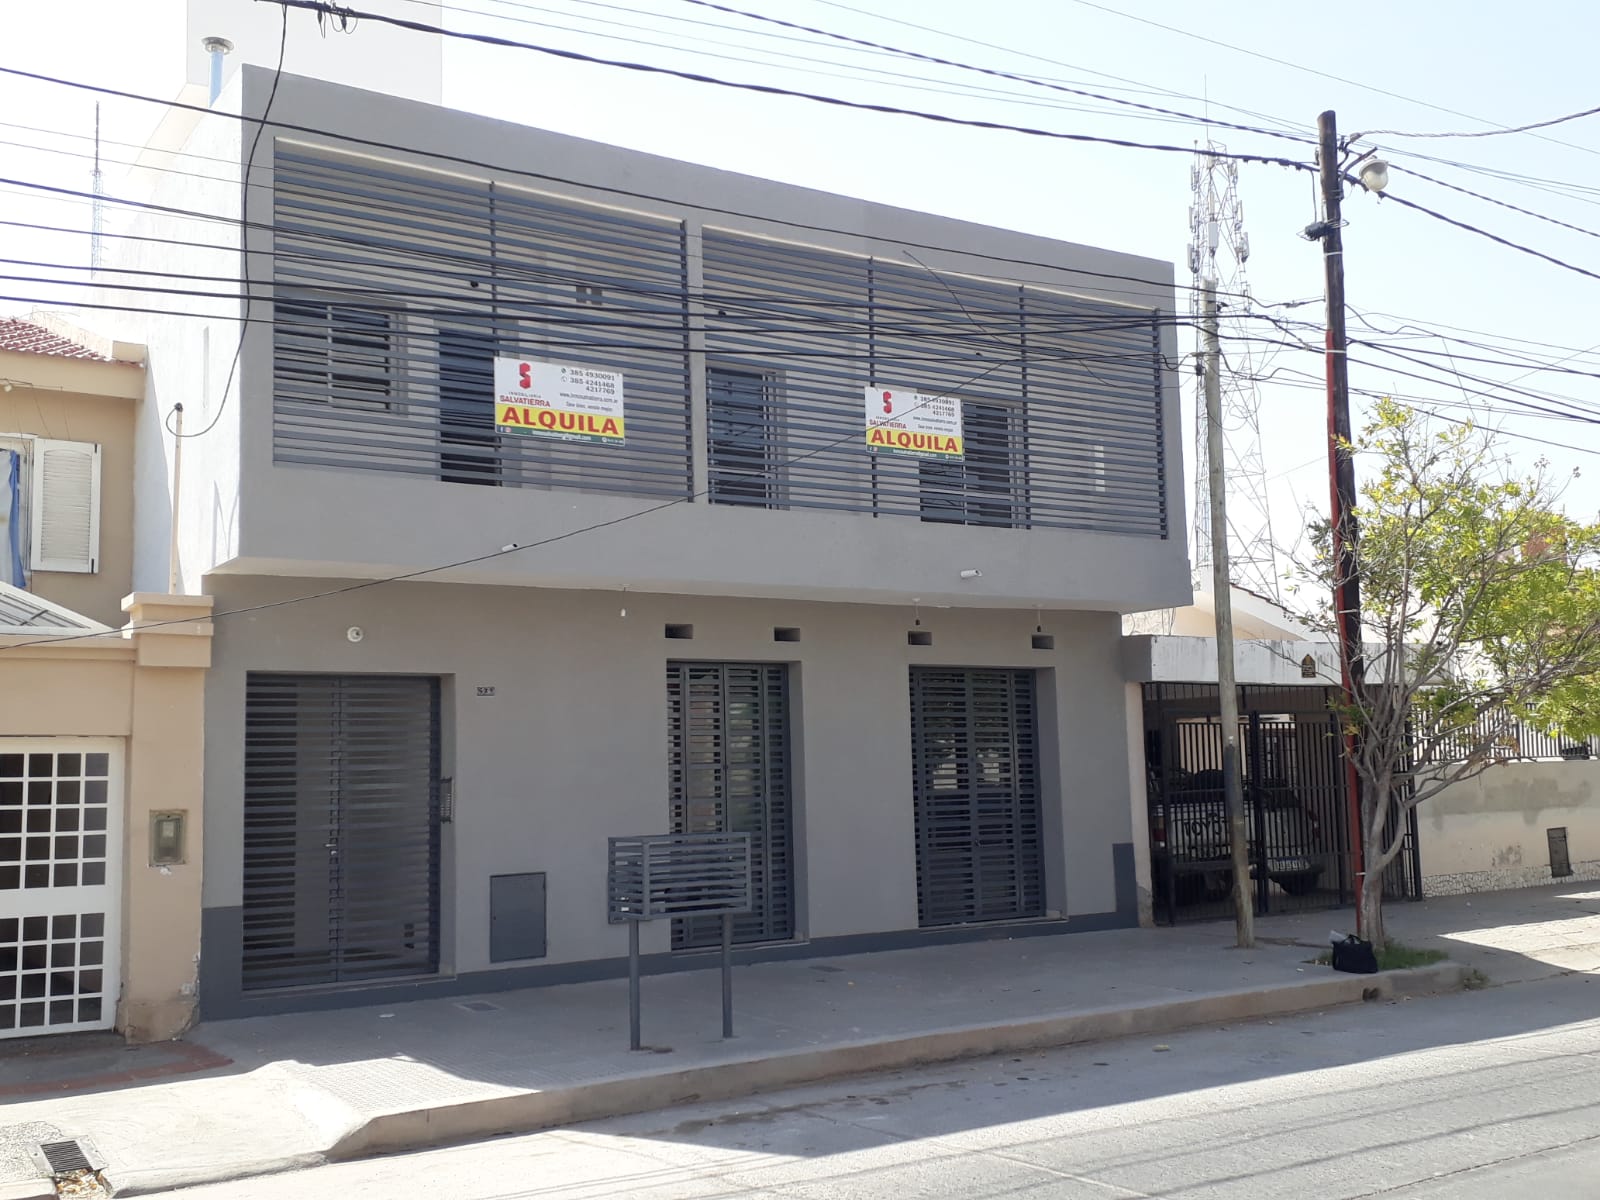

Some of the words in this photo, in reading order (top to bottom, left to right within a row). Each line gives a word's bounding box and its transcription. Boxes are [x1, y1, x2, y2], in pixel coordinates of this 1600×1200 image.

[570, 369, 584, 378] 385
[570, 377, 584, 386] 385
[500, 395, 551, 407] SALVATIERRA
[502, 407, 619, 435] ALQUILA
[871, 429, 958, 452] ALQUILA
